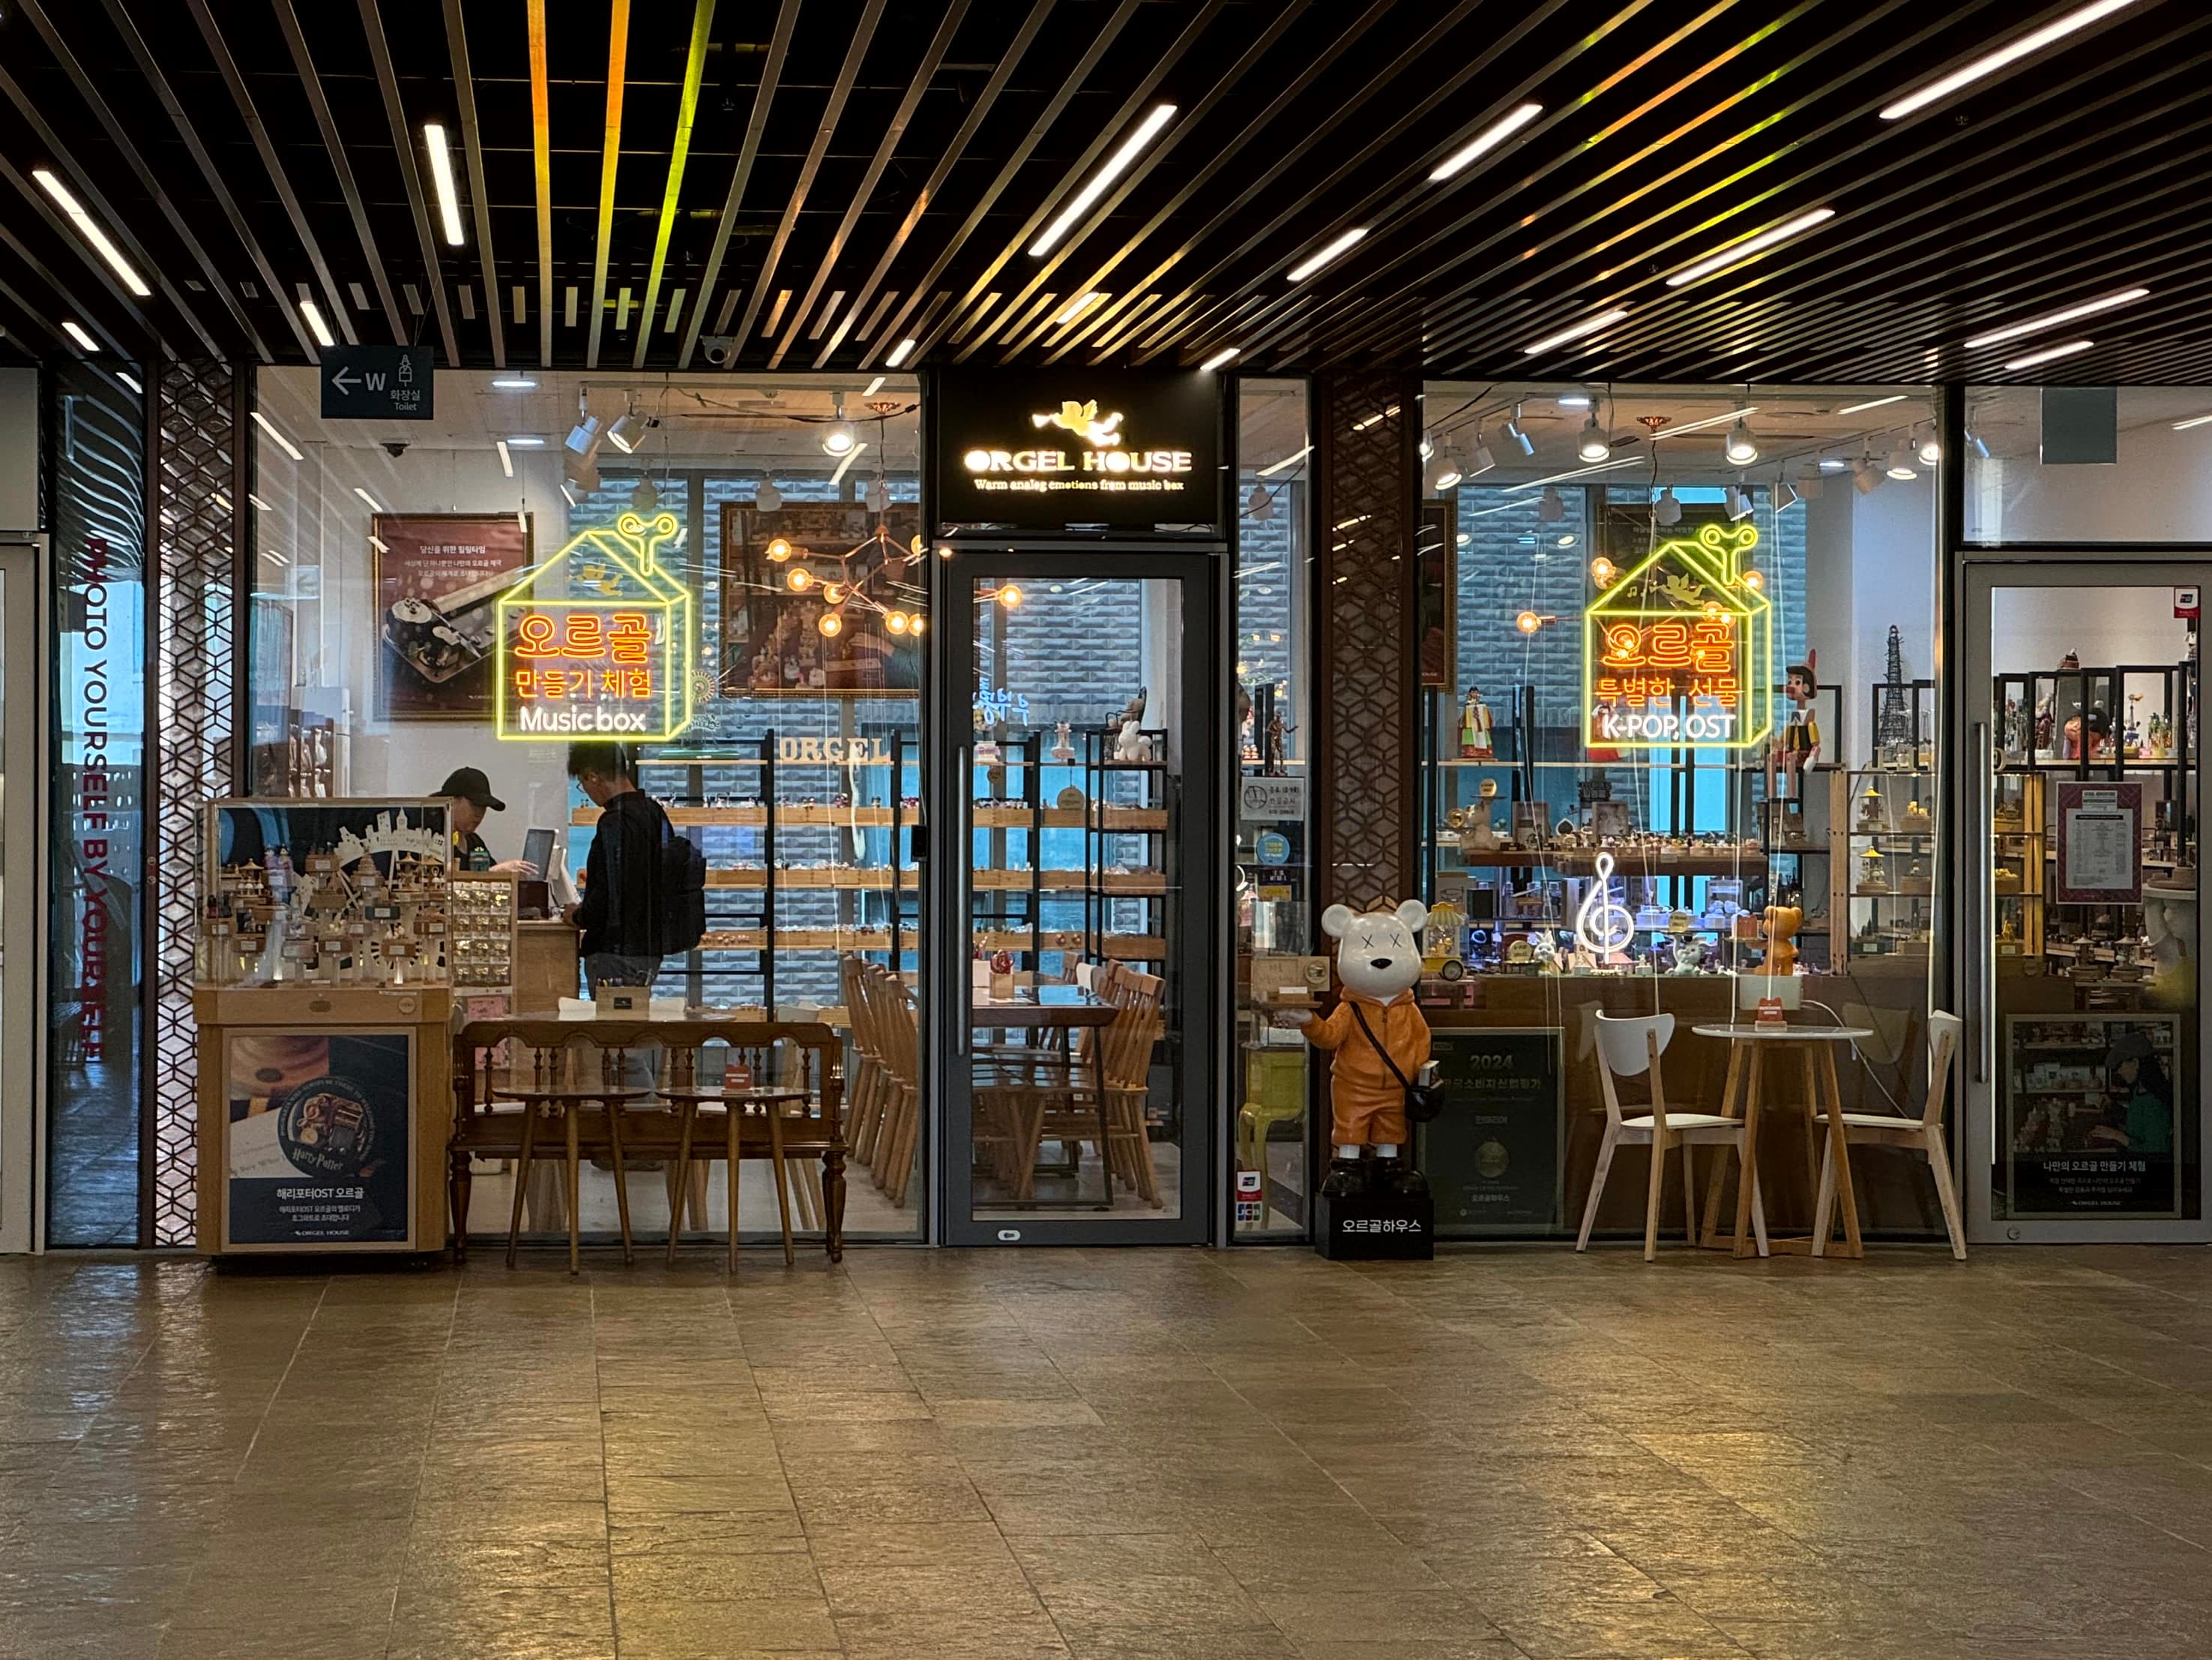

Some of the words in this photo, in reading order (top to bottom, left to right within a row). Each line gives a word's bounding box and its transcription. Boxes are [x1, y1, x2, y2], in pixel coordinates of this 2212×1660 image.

[365, 373, 386, 391] W
[390, 389, 421, 400] 화장실
[394, 402, 417, 411] Toilet
[964, 450, 1076, 472] ORGEL
[1083, 451, 1193, 472] HOUSE
[974, 479, 1008, 491] Warm
[1010, 479, 1047, 492] analog
[1049, 480, 1098, 490] emotions
[1100, 479, 1127, 491] from
[1128, 479, 1161, 490] music
[1163, 480, 1184, 490] box
[420, 545, 442, 555] 당신을
[442, 545, 456, 555] 위한
[458, 545, 486, 555] 힐링타임
[83, 538, 109, 650] PHOTO
[514, 613, 652, 665] 오르골
[1602, 623, 1735, 673] 오르골
[515, 669, 593, 700] 만들기
[600, 668, 652, 700] 체험
[1595, 677, 1675, 708] 특별한
[1688, 677, 1745, 708] 선물
[1603, 714, 1680, 741] K-POP,
[1686, 714, 1737, 739] OST
[83, 660, 108, 830] YOURSELF
[780, 737, 892, 762] ORGEL
[83, 839, 108, 881] BY
[1470, 1055, 1513, 1069] 2024
[292, 1147, 317, 1164] Harry
[316, 1153, 343, 1170] Potter
[2043, 1160, 2070, 1172] 나만의
[2071, 1160, 2098, 1172] 오르골
[2100, 1160, 2127, 1172] 만들기
[2128, 1160, 2147, 1172] 체험
[276, 1188, 334, 1200] 해리포터OST
[335, 1187, 364, 1200] 오르골
[1342, 1219, 1422, 1233] 오르골하우스
